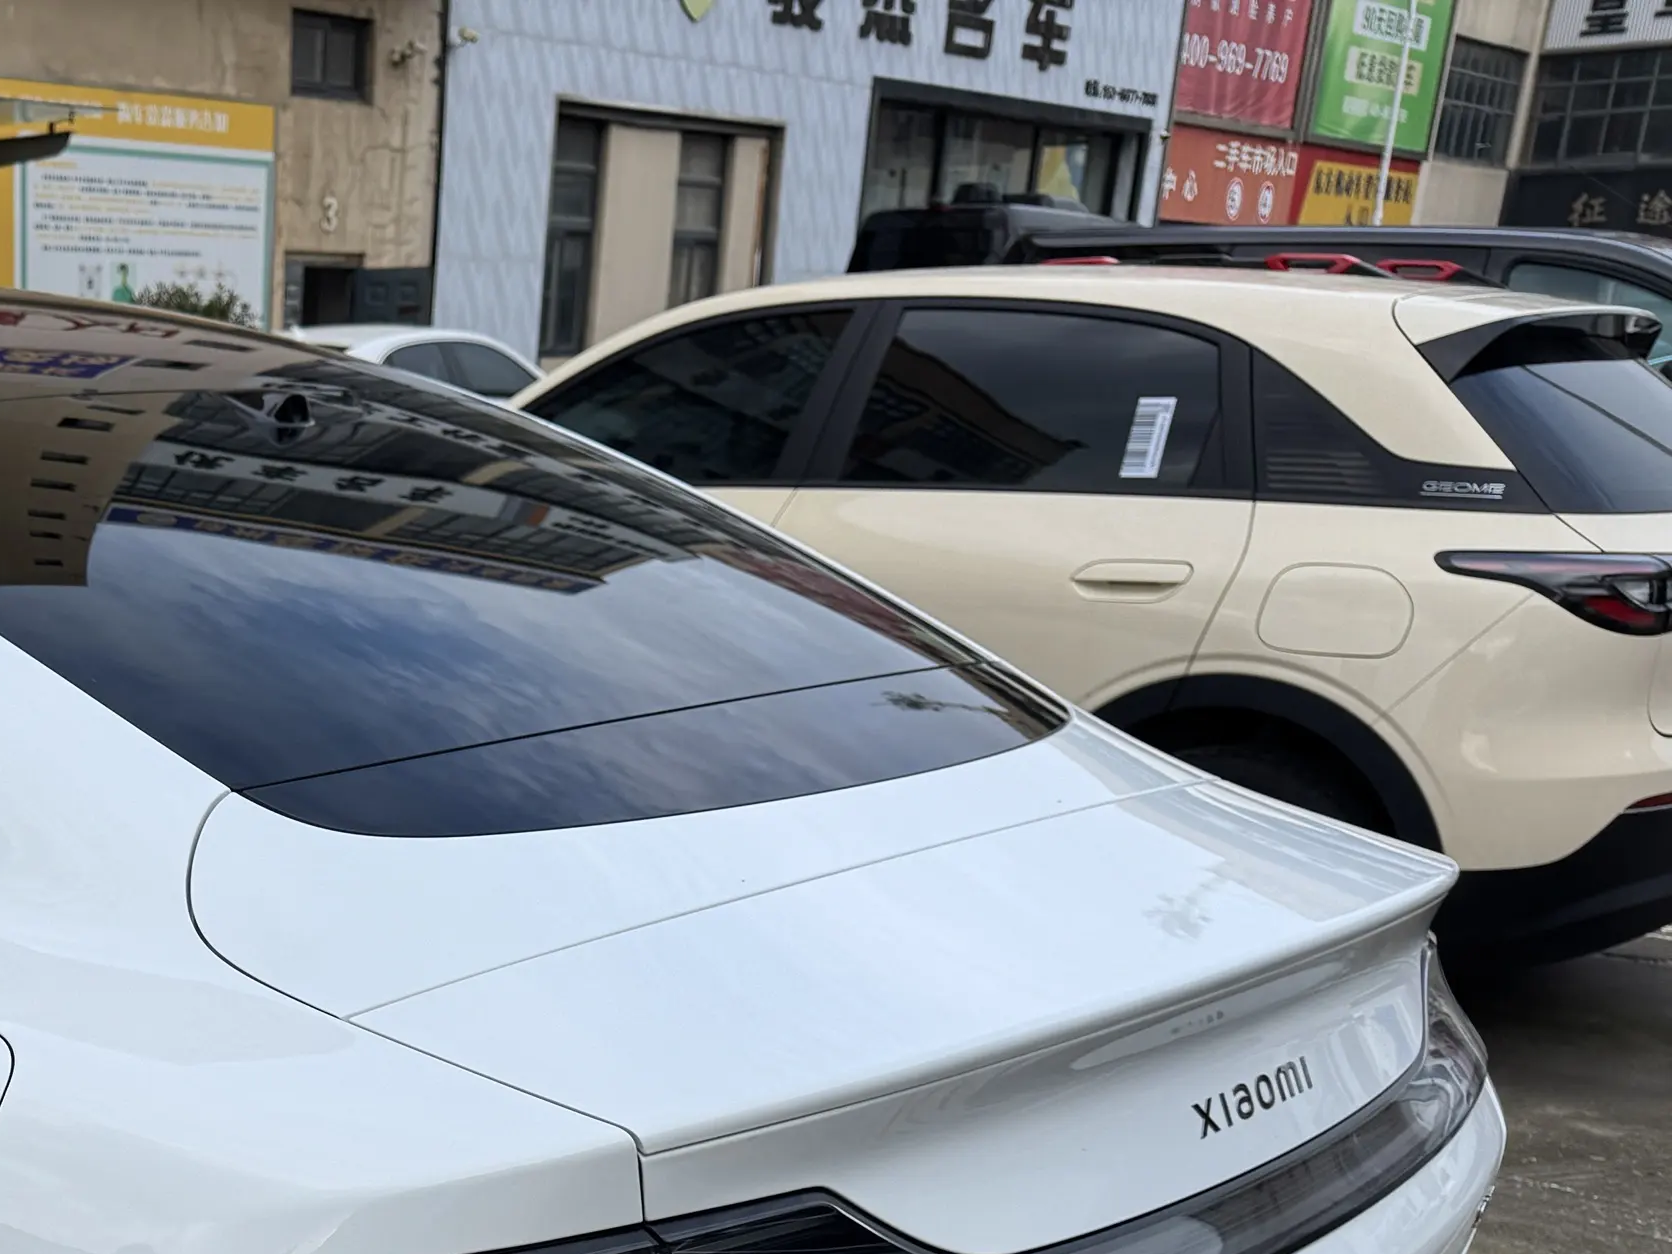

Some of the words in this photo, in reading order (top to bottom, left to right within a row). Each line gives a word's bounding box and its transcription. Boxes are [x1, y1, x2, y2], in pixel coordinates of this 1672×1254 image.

[1213, 140, 1298, 177] 二手车市场入口
[321, 197, 340, 232] 3
[1191, 1055, 1313, 1139] xiaomi
